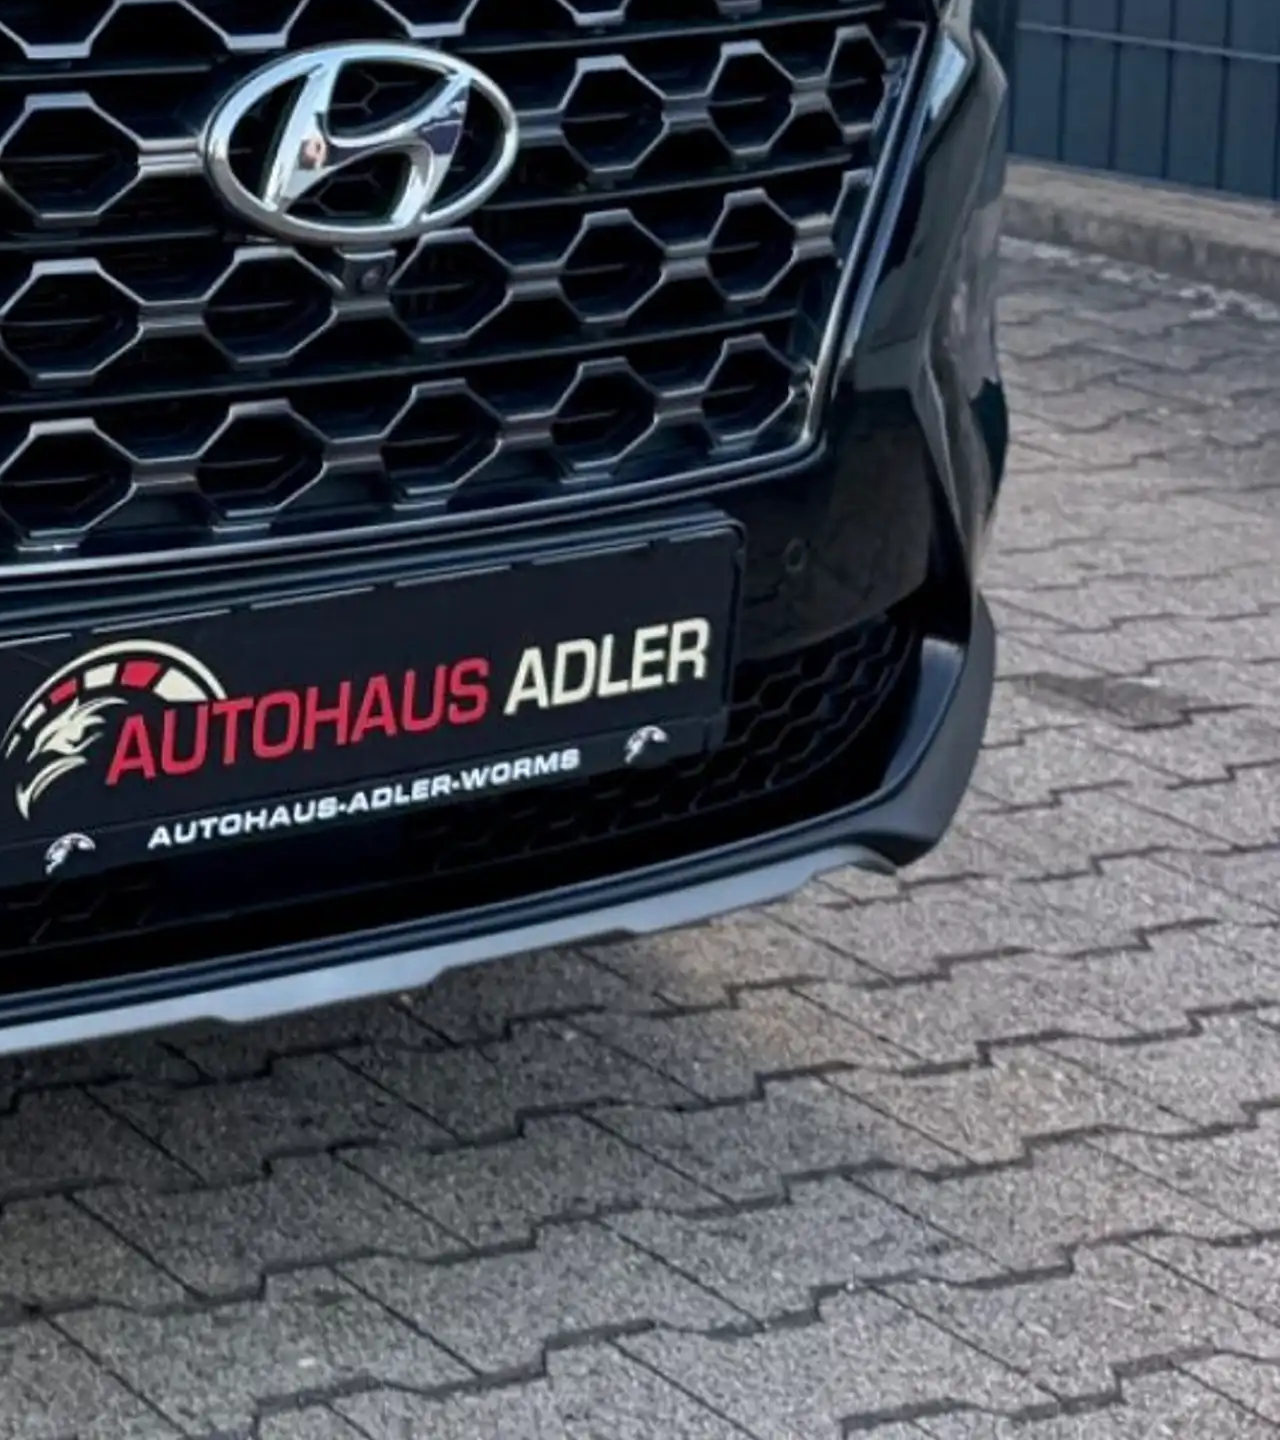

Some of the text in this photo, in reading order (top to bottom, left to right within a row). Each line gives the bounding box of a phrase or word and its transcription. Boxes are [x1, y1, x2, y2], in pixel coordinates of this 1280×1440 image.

[105, 617, 711, 786] AUTOHAUS ADLER
[147, 748, 582, 849] AUTOHAUS-ADLER-WORMS
